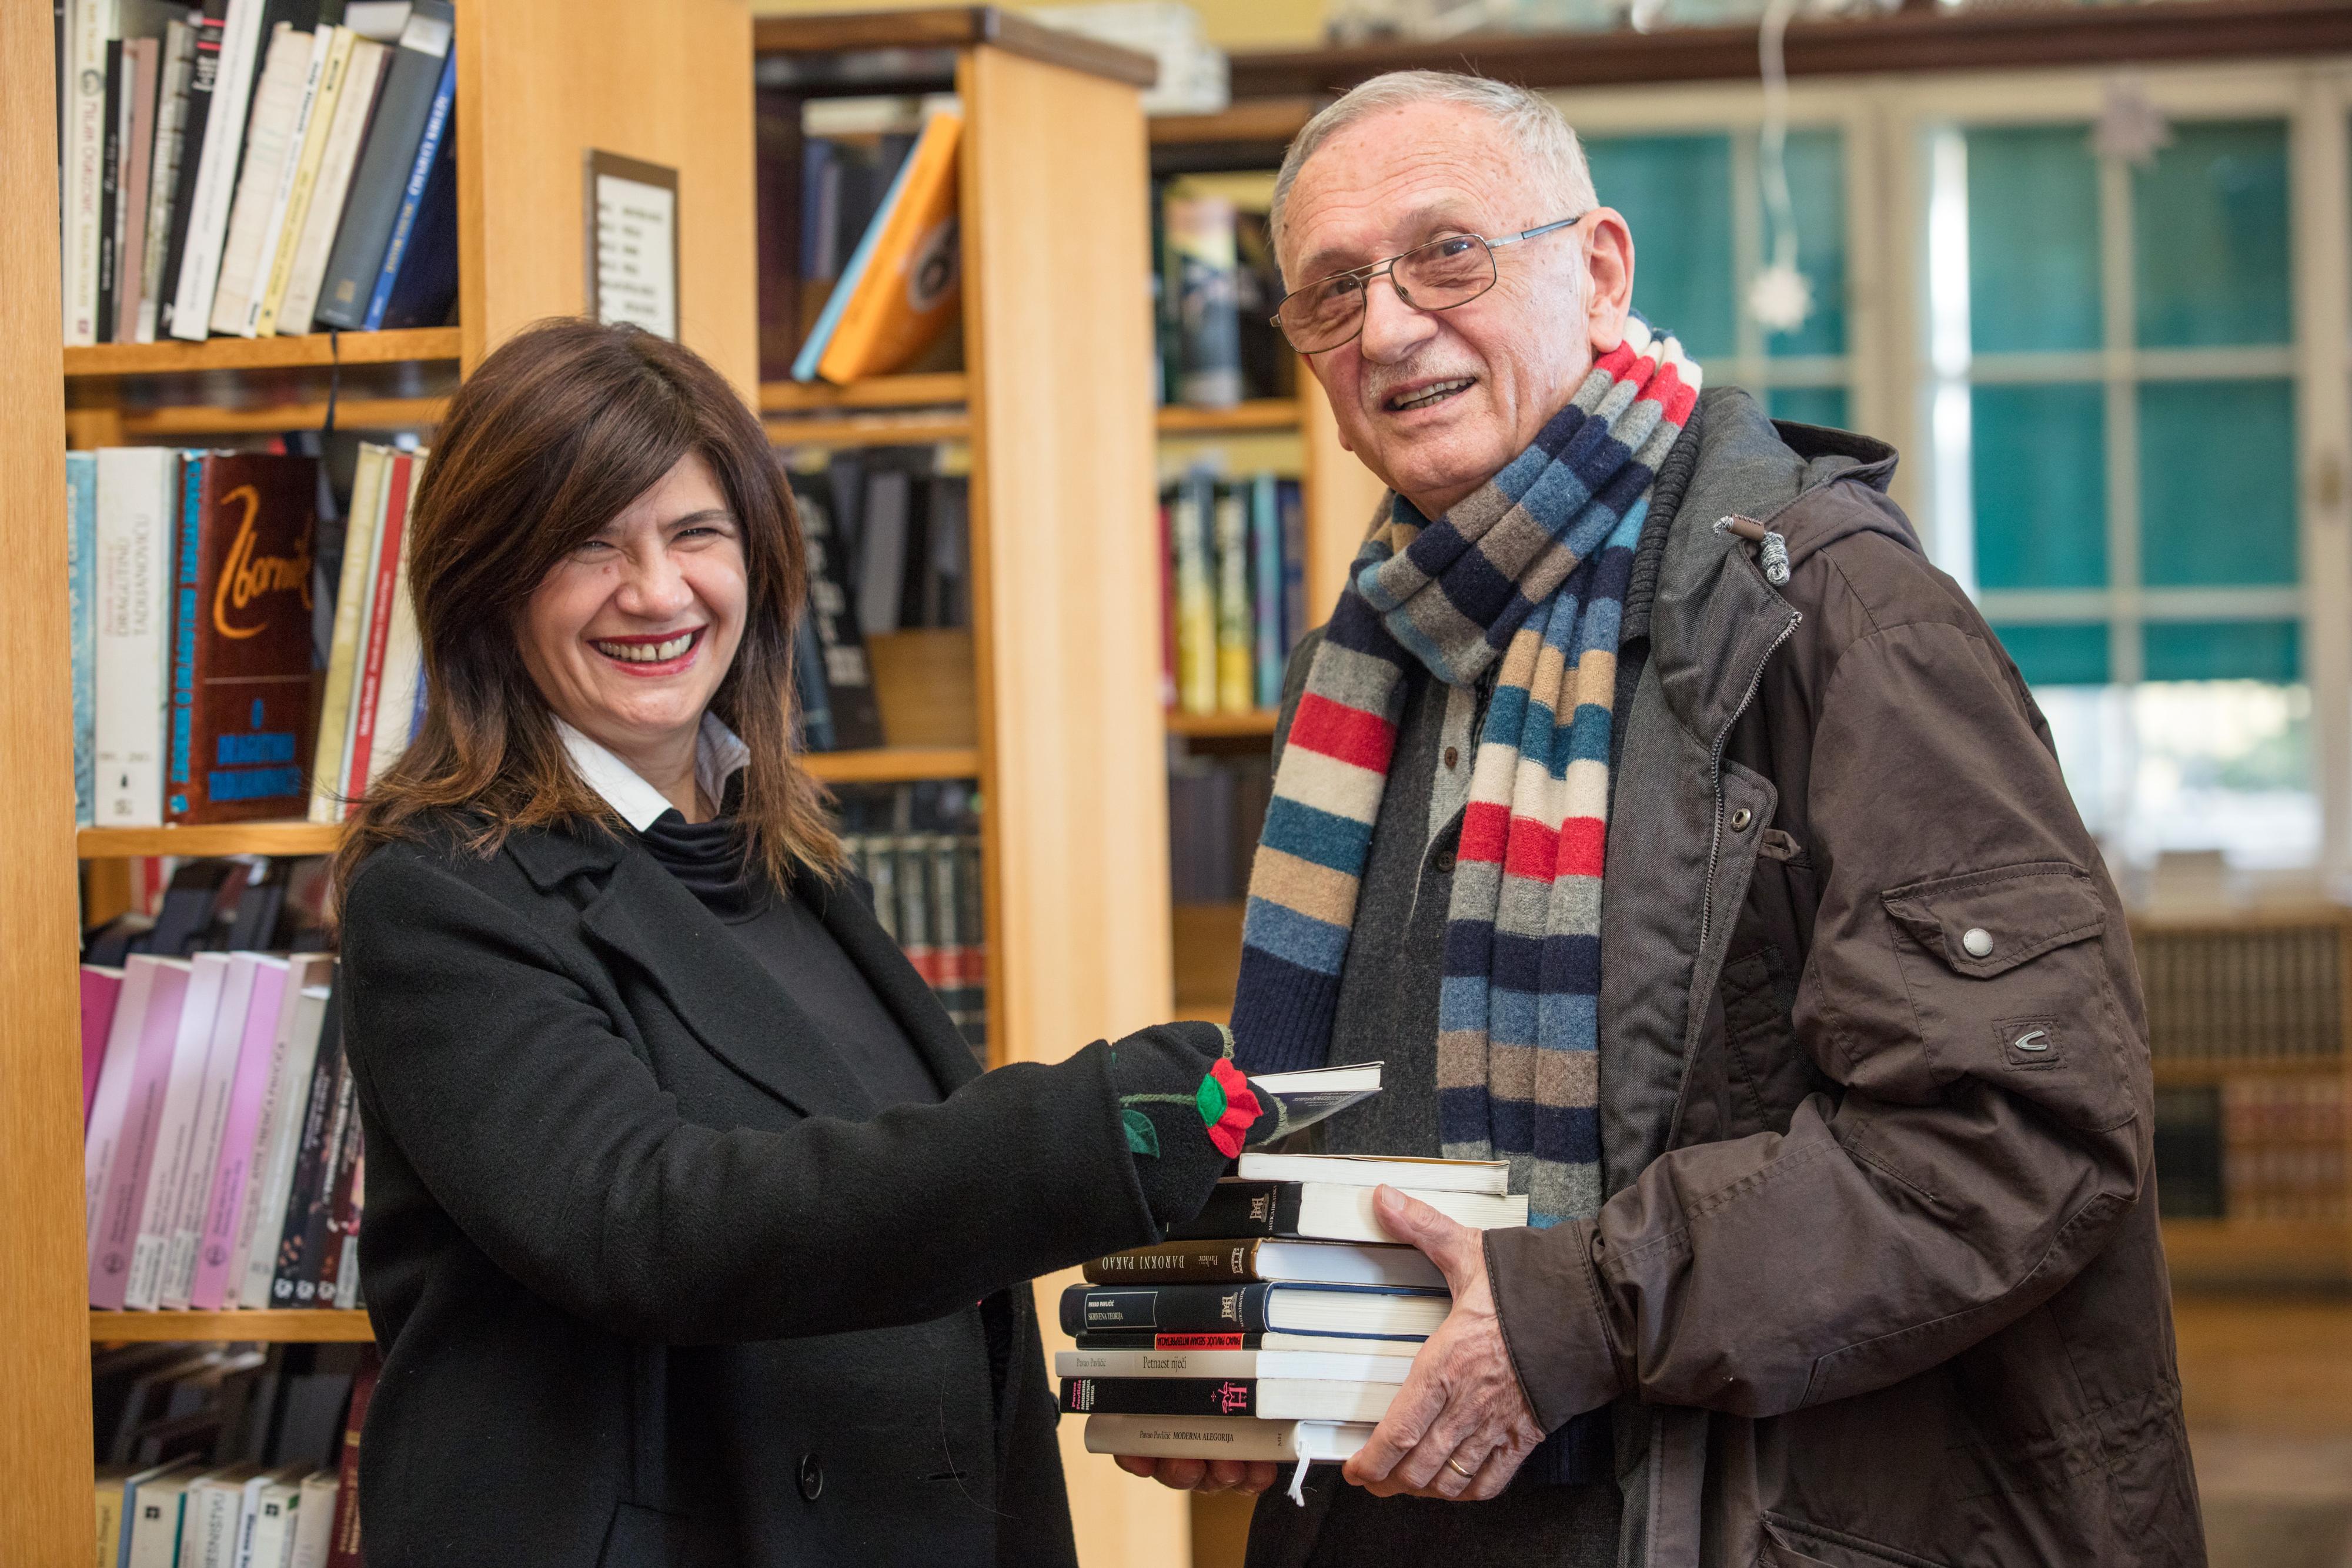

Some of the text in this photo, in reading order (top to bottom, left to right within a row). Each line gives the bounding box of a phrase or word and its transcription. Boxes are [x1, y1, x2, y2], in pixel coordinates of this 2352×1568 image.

[1102, 1255, 1218, 1271] Pavličić BAROKNI PAKAO
[1100, 1299, 1114, 1308] PAVLIČIĆ
[1088, 1312, 1124, 1322] SKRIVENA TEORIJA
[1157, 1336, 1189, 1346] INTERPRETACIJA
[1188, 1336, 1206, 1346] SEDAM
[1225, 1336, 1241, 1345] PAVAO
[1076, 1358, 1106, 1368] Pavao Pavličić
[1143, 1356, 1187, 1373] Petnaest riječi
[1140, 1430, 1234, 1443] Pavao Pavličić MODERNA ALEGORIJA
